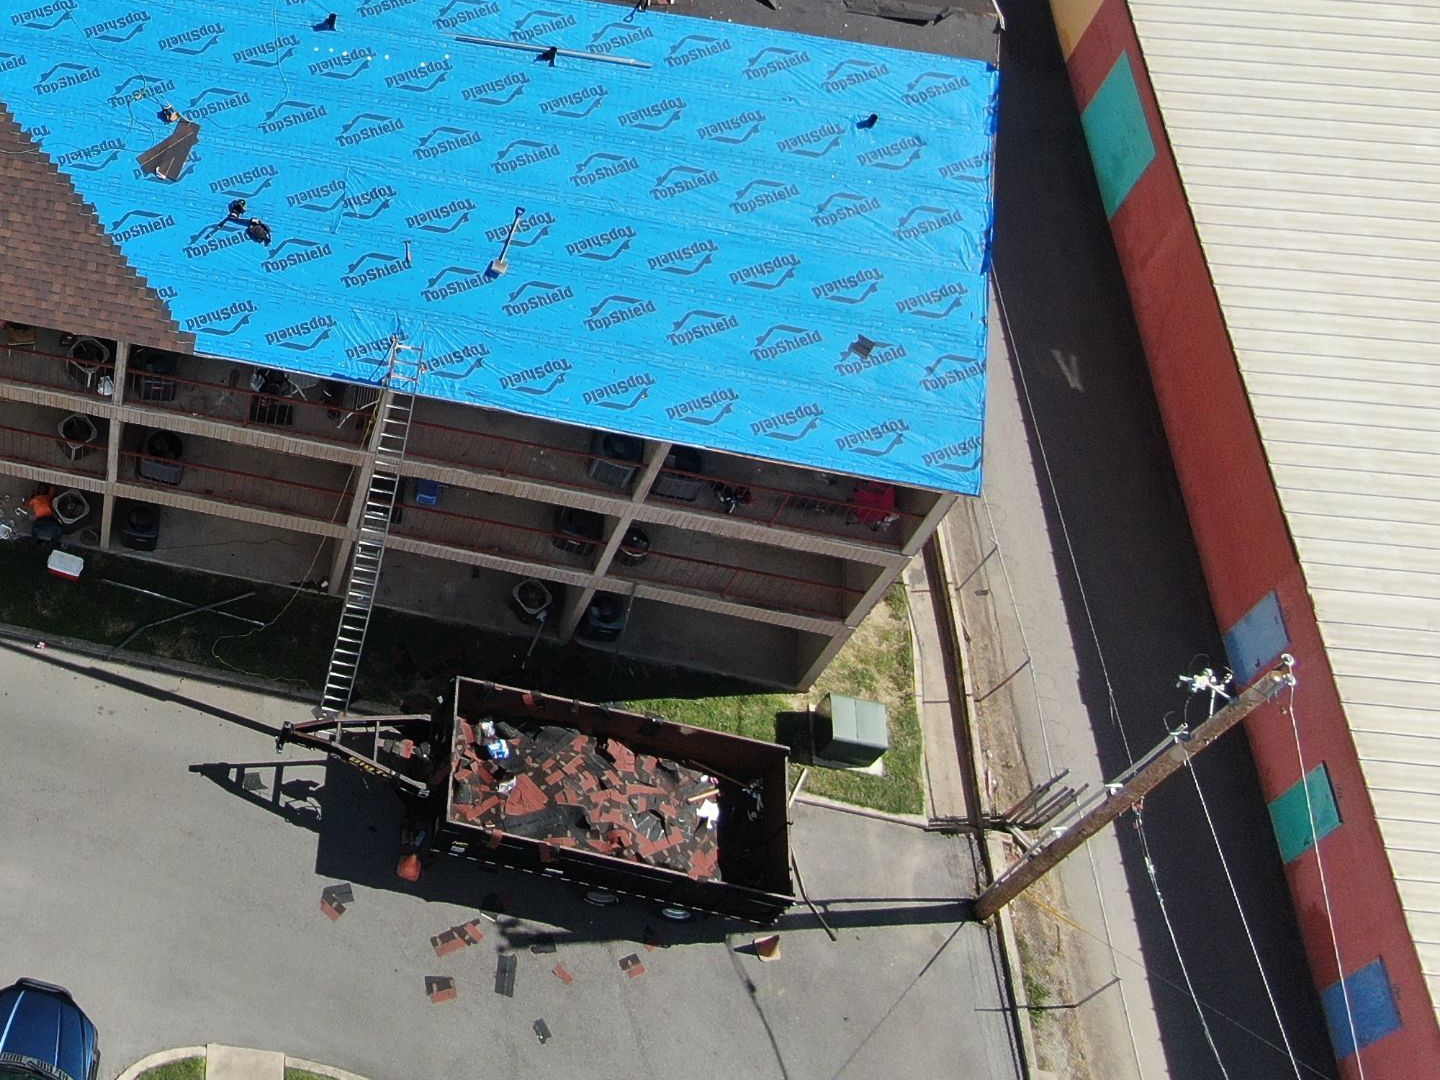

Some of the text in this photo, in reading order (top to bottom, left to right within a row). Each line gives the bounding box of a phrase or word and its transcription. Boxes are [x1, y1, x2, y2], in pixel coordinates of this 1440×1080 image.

[11, 0, 78, 26] TopShield
[84, 11, 151, 38] TopShield
[433, 2, 500, 30] TopShield
[159, 23, 225, 51] TopShield
[509, 15, 577, 42] TopShield
[233, 34, 300, 63] TopShield
[308, 47, 376, 75] TopShield
[663, 39, 732, 68] TopShield
[385, 59, 452, 88] TopShield
[742, 51, 810, 80] TopShield
[821, 64, 889, 93] TopShield
[33, 67, 101, 96] TopShield
[462, 72, 530, 101] TopShield
[539, 85, 608, 114] TopShield
[618, 97, 687, 126] TopShield
[259, 105, 327, 135] TopShield
[335, 118, 405, 147] TopShield
[697, 110, 766, 139] TopShield
[413, 131, 481, 160] TopShield
[777, 123, 845, 153] TopShield
[856, 136, 927, 166] TopShield
[491, 144, 560, 174] TopShield
[210, 164, 279, 193] TopShield
[286, 179, 345, 207] opShield
[649, 170, 719, 200] TopShield
[343, 185, 397, 210] TopShi
[730, 184, 800, 215] TopShield
[406, 198, 476, 228] TopShield
[485, 212, 556, 242] TopSeld
[810, 198, 881, 228] TopShield
[892, 210, 963, 241] TopShield
[566, 225, 637, 255] TopShield
[647, 239, 719, 269] TopShield
[262, 244, 332, 273] TopShield
[729, 254, 801, 284] TopShield
[340, 260, 411, 289] TopShield
[421, 273, 493, 303] TopShield
[812, 267, 884, 298] TopShield
[502, 286, 574, 317] TopShield
[896, 282, 968, 313] TopShield
[186, 300, 257, 330] TopShield
[265, 315, 337, 344] TopShield
[584, 301, 656, 331] TopShield
[666, 315, 739, 346] TopShield
[751, 330, 823, 361] TopShield
[499, 358, 572, 389] TopShield
[584, 373, 655, 404] TopShield
[920, 361, 986, 391] TopShiel
[665, 388, 739, 419] TopShield
[751, 403, 824, 436] TopShield
[836, 419, 909, 451] TopShield
